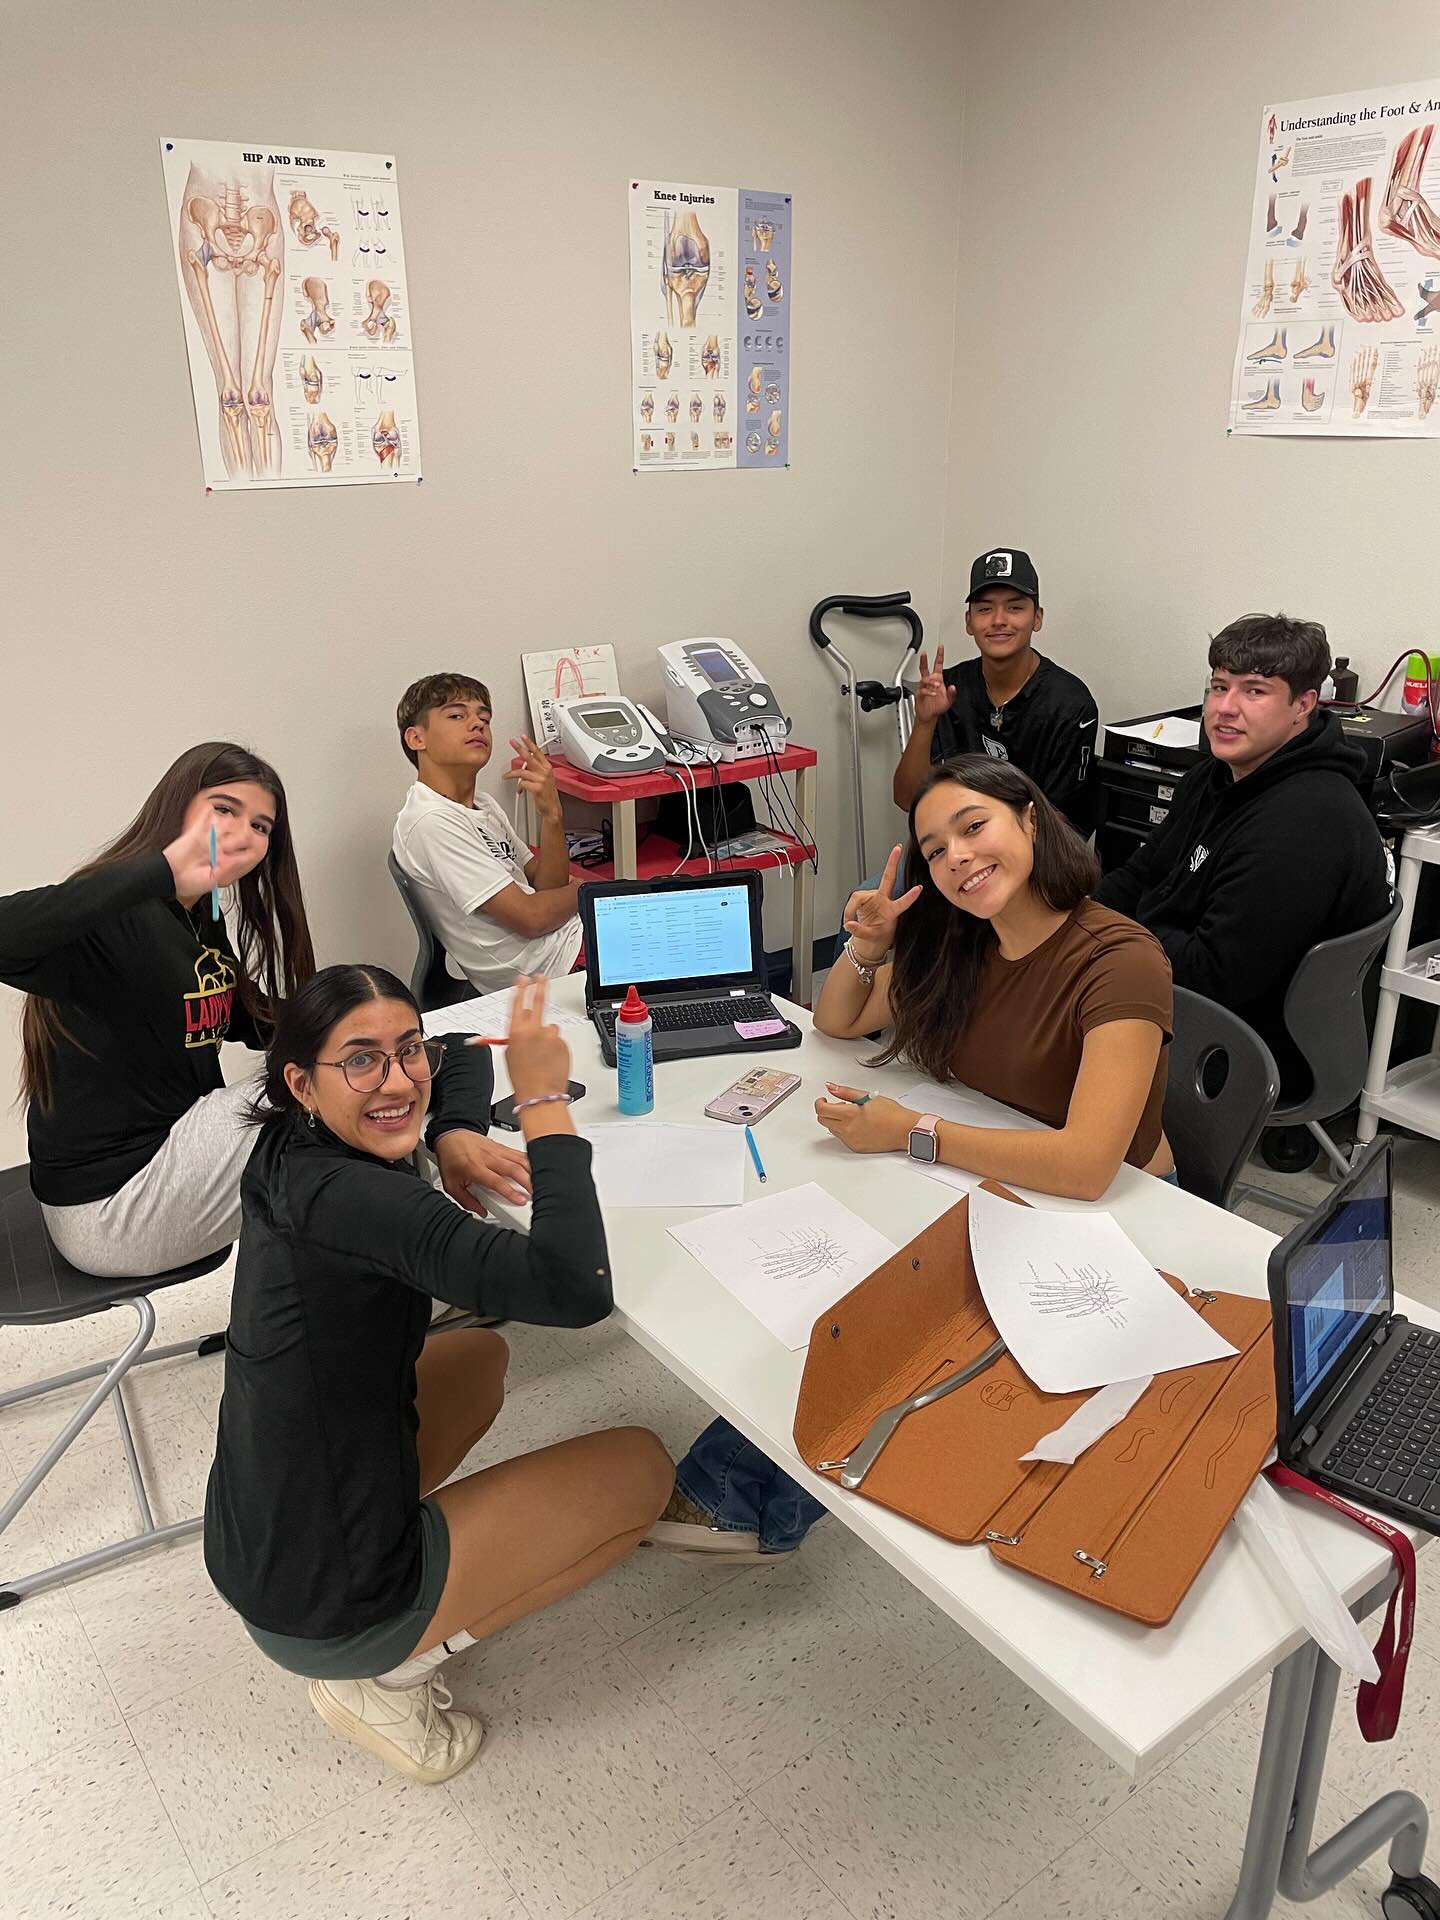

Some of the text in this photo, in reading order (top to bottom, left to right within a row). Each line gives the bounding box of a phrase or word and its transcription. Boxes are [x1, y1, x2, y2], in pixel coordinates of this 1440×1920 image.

[1280, 99, 1440, 132] Understanding the Foot & An
[242, 152, 326, 167] HIP AND KNEE
[653, 190, 715, 205] Knee Injuries
